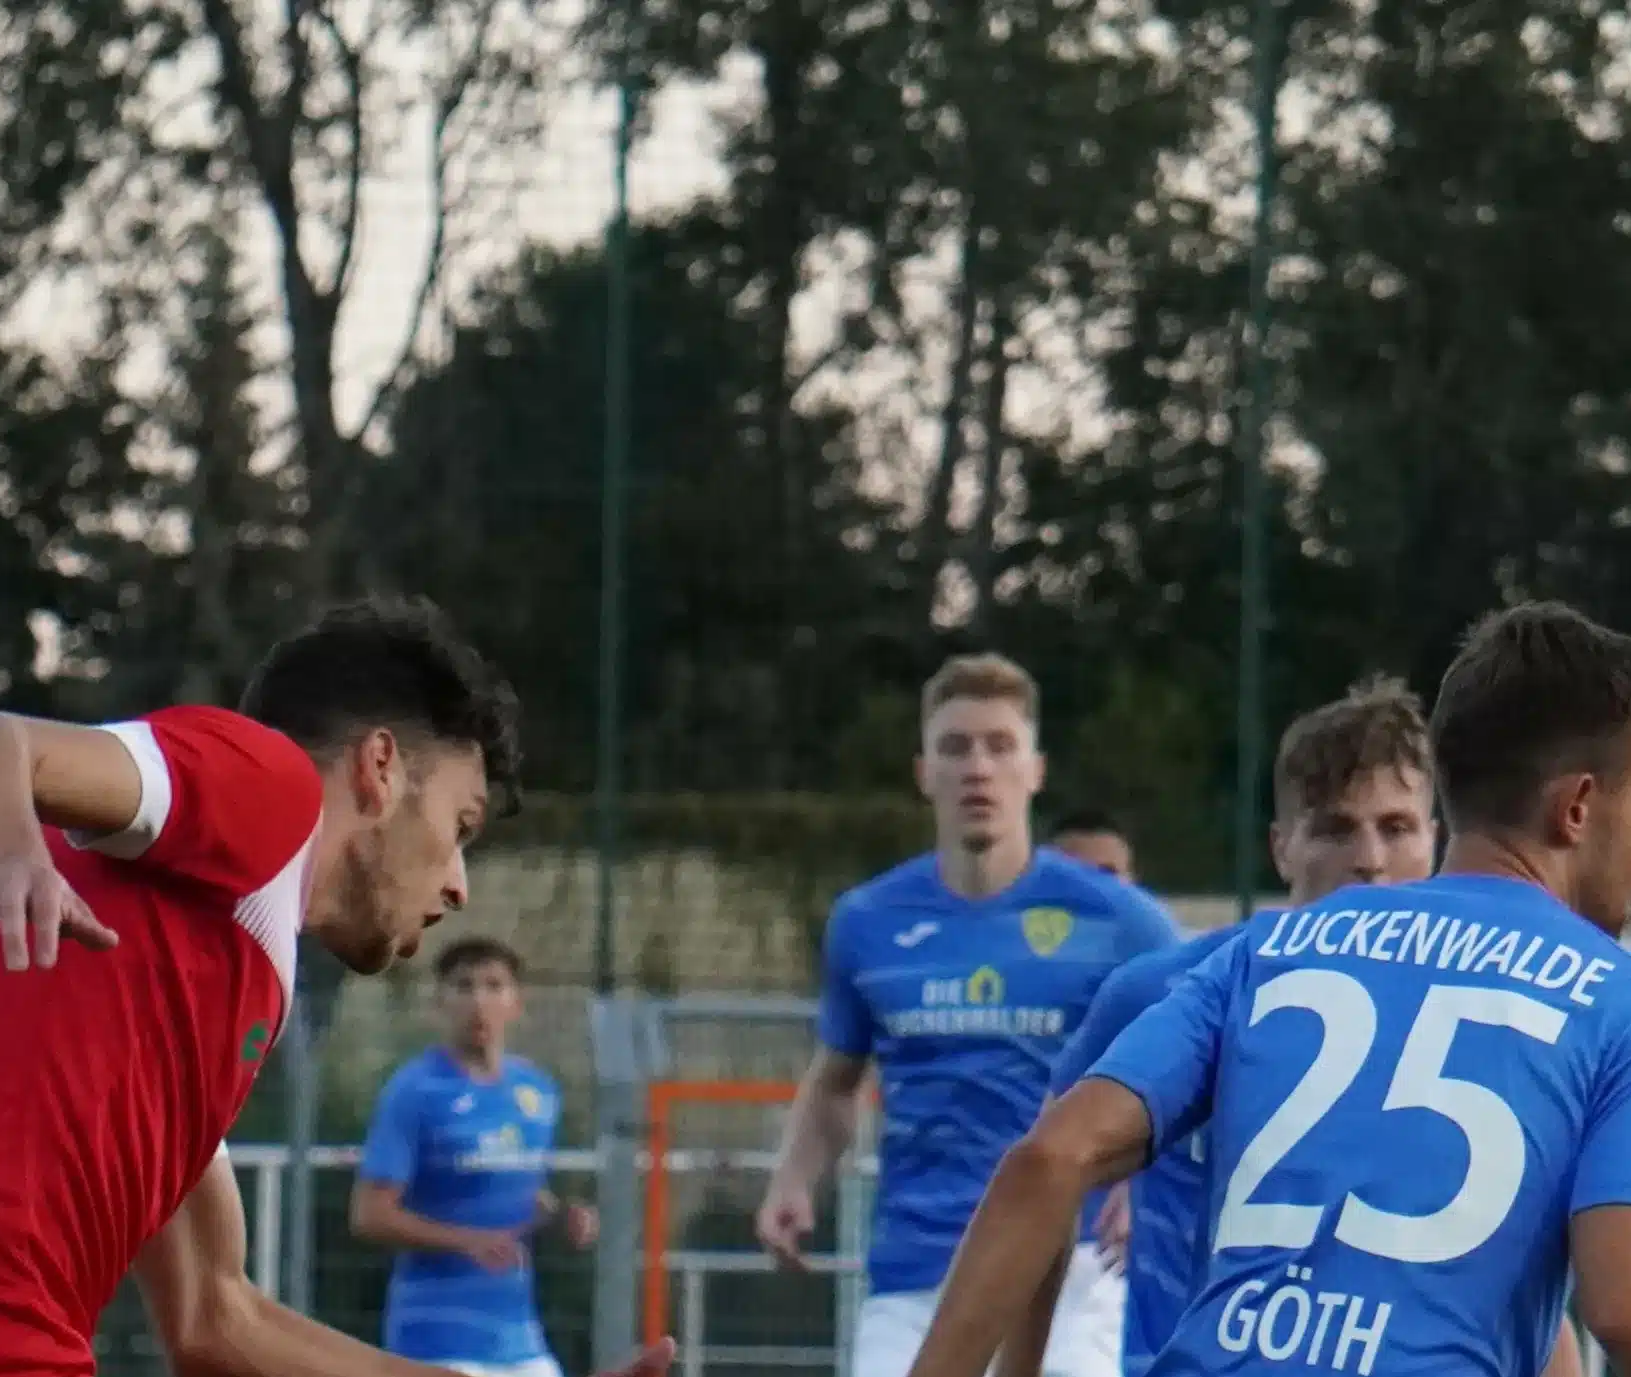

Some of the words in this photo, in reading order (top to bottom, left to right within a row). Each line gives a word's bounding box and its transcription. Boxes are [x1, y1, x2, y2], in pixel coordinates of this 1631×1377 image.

[1256, 909, 1616, 1006] LUCKENWALDE
[1212, 967, 1569, 1263] 25
[1216, 1265, 1393, 1377] GÖTH
